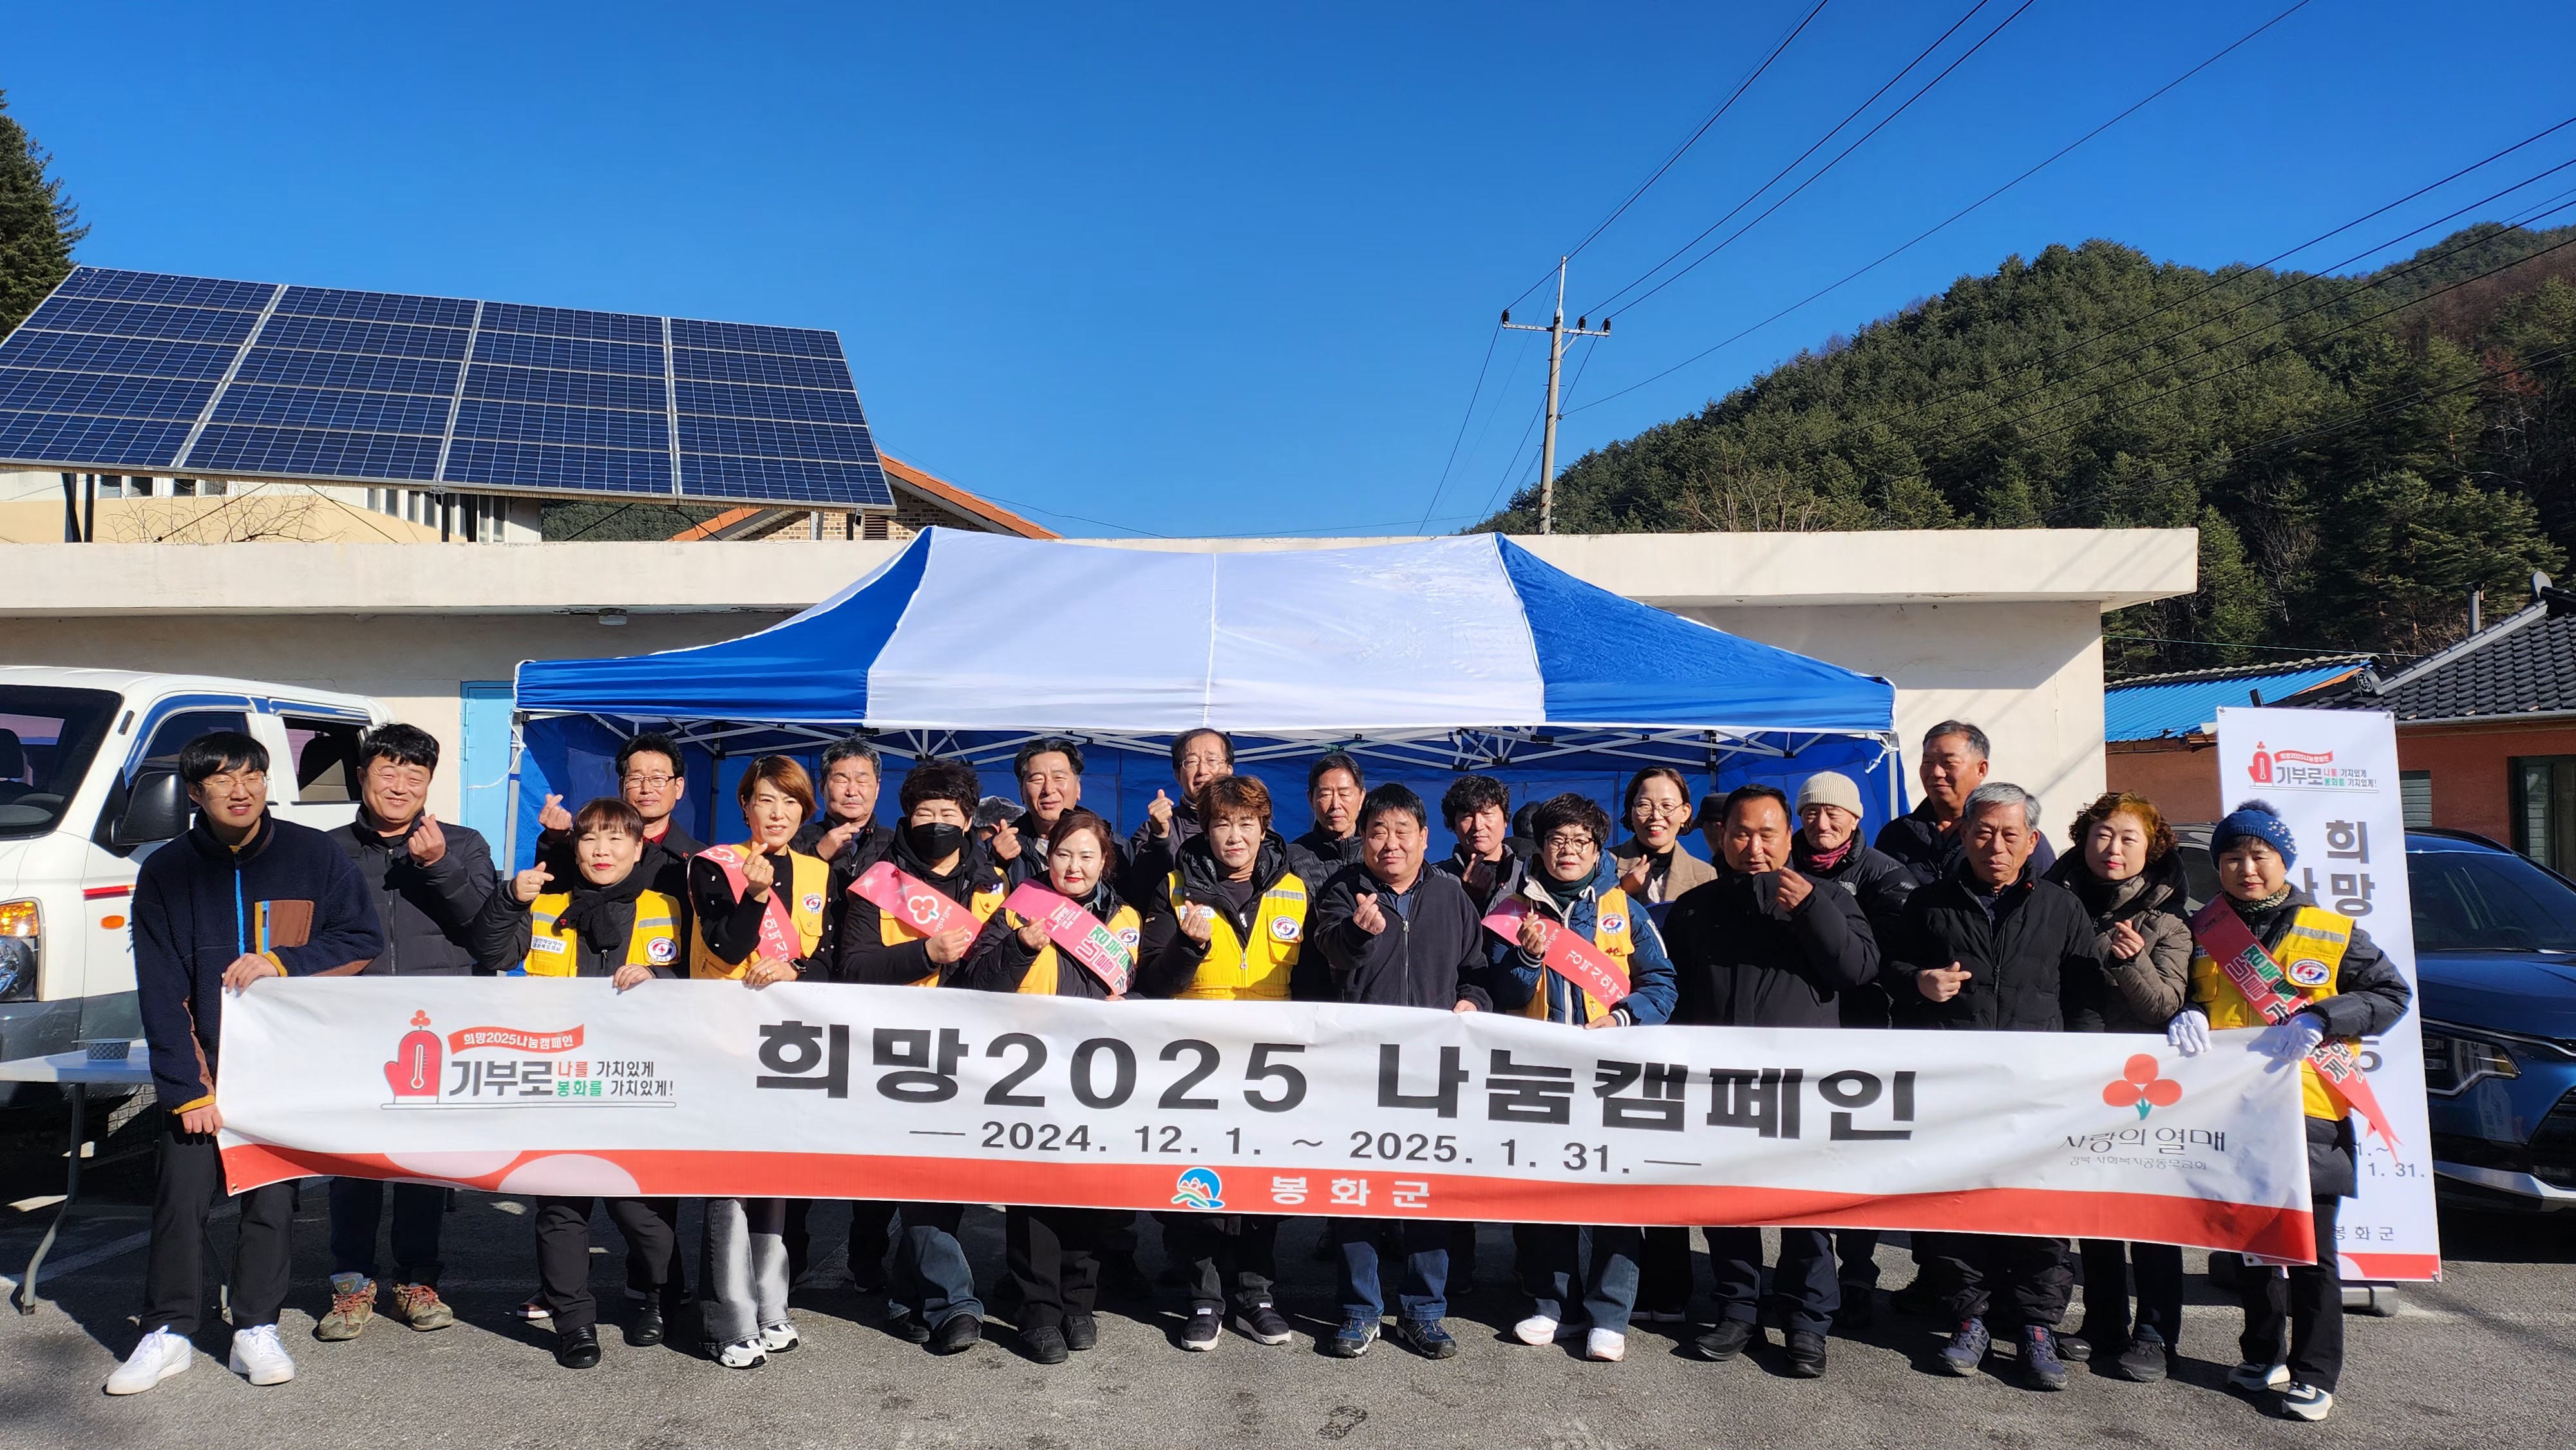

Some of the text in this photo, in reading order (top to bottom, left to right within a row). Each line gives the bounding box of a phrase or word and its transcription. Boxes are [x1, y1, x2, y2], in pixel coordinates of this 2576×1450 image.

[2276, 766, 2323, 786] 기부로
[1075, 938, 1116, 976] 나를
[2224, 957, 2270, 1001] 나를
[2240, 943, 2300, 1003] 경북을
[463, 1031, 574, 1050] 희망2025나눔캠페인
[449, 1061, 553, 1097] 기부로
[558, 1061, 654, 1078] 나를 가치있게
[756, 1020, 1917, 1142] 희망2025 나눔캠페인
[556, 1080, 674, 1097] 봉화를 가치있게!
[981, 1121, 1108, 1153] 2024.
[1134, 1124, 1198, 1154] 12.
[1226, 1127, 1262, 1156] 1.
[1349, 1131, 1473, 1164] 2025.
[1500, 1138, 1537, 1168] 1.
[1562, 1143, 1631, 1174] 31.
[2056, 1127, 2226, 1156] 사랑의 열매
[2070, 1156, 2206, 1170] 경북 사회복지공동모금회
[2367, 1162, 2425, 1178] 1. 31.
